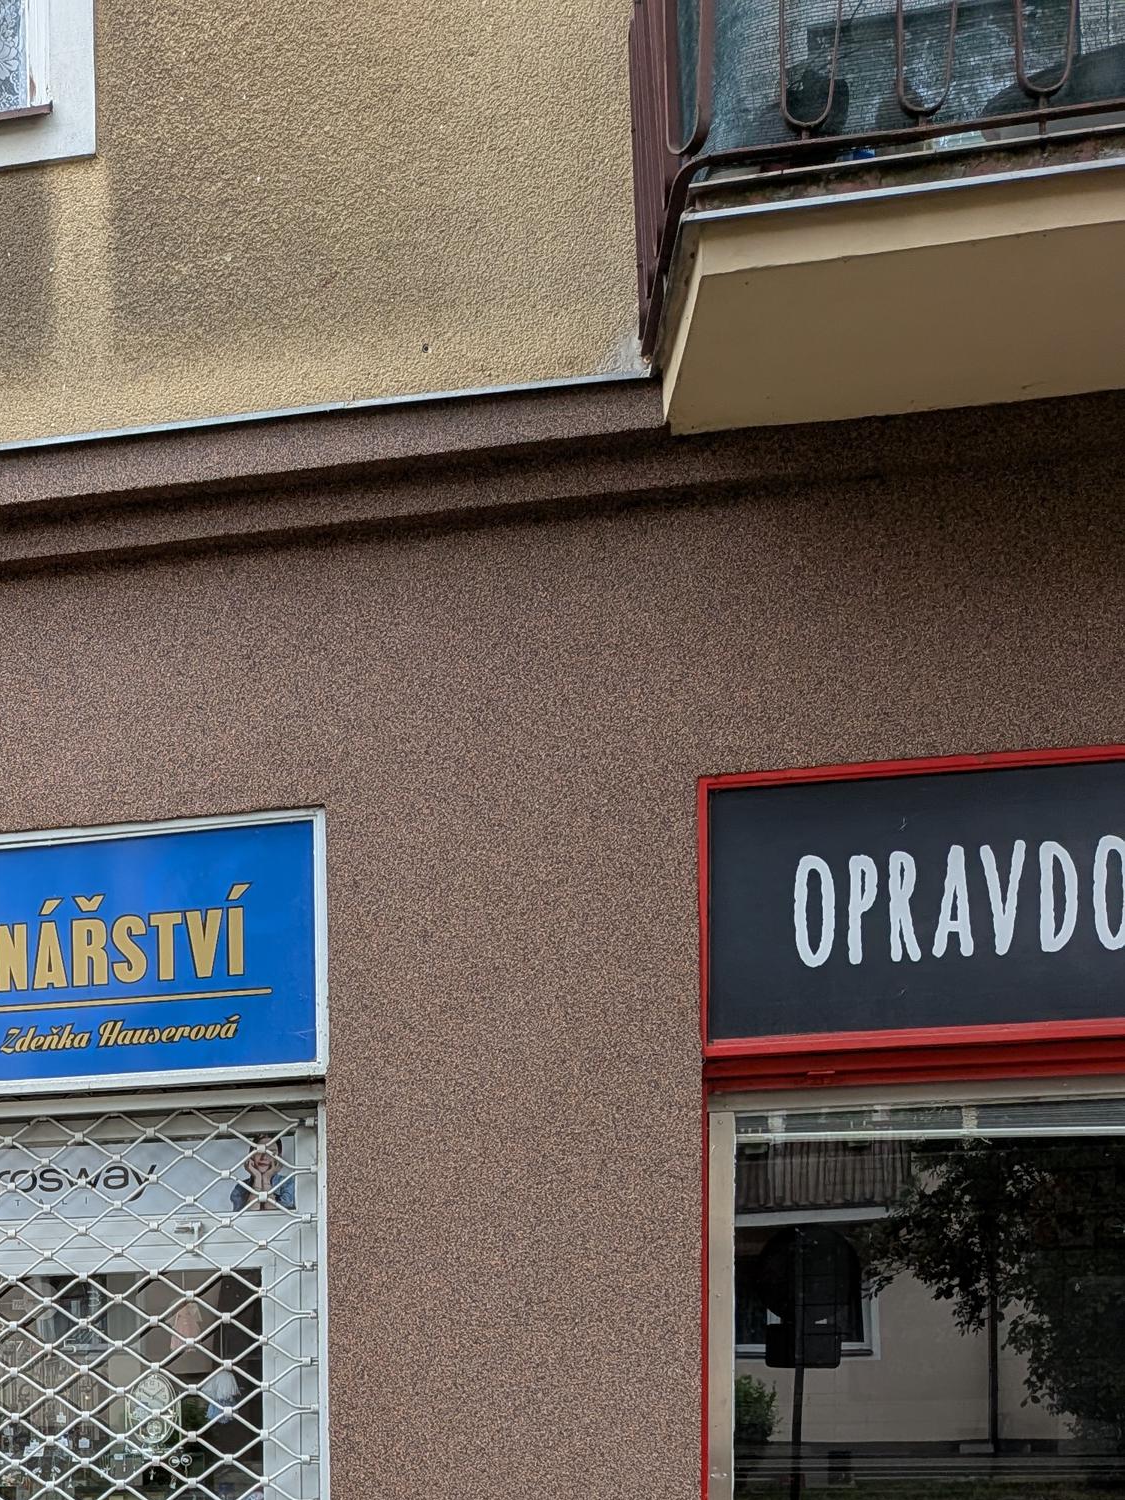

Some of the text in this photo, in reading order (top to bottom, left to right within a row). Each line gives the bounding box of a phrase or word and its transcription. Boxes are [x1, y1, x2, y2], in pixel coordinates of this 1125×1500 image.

[793, 834, 1125, 968] OPRAVDO
[0, 1013, 242, 1054] Zdeňka Hauserová
